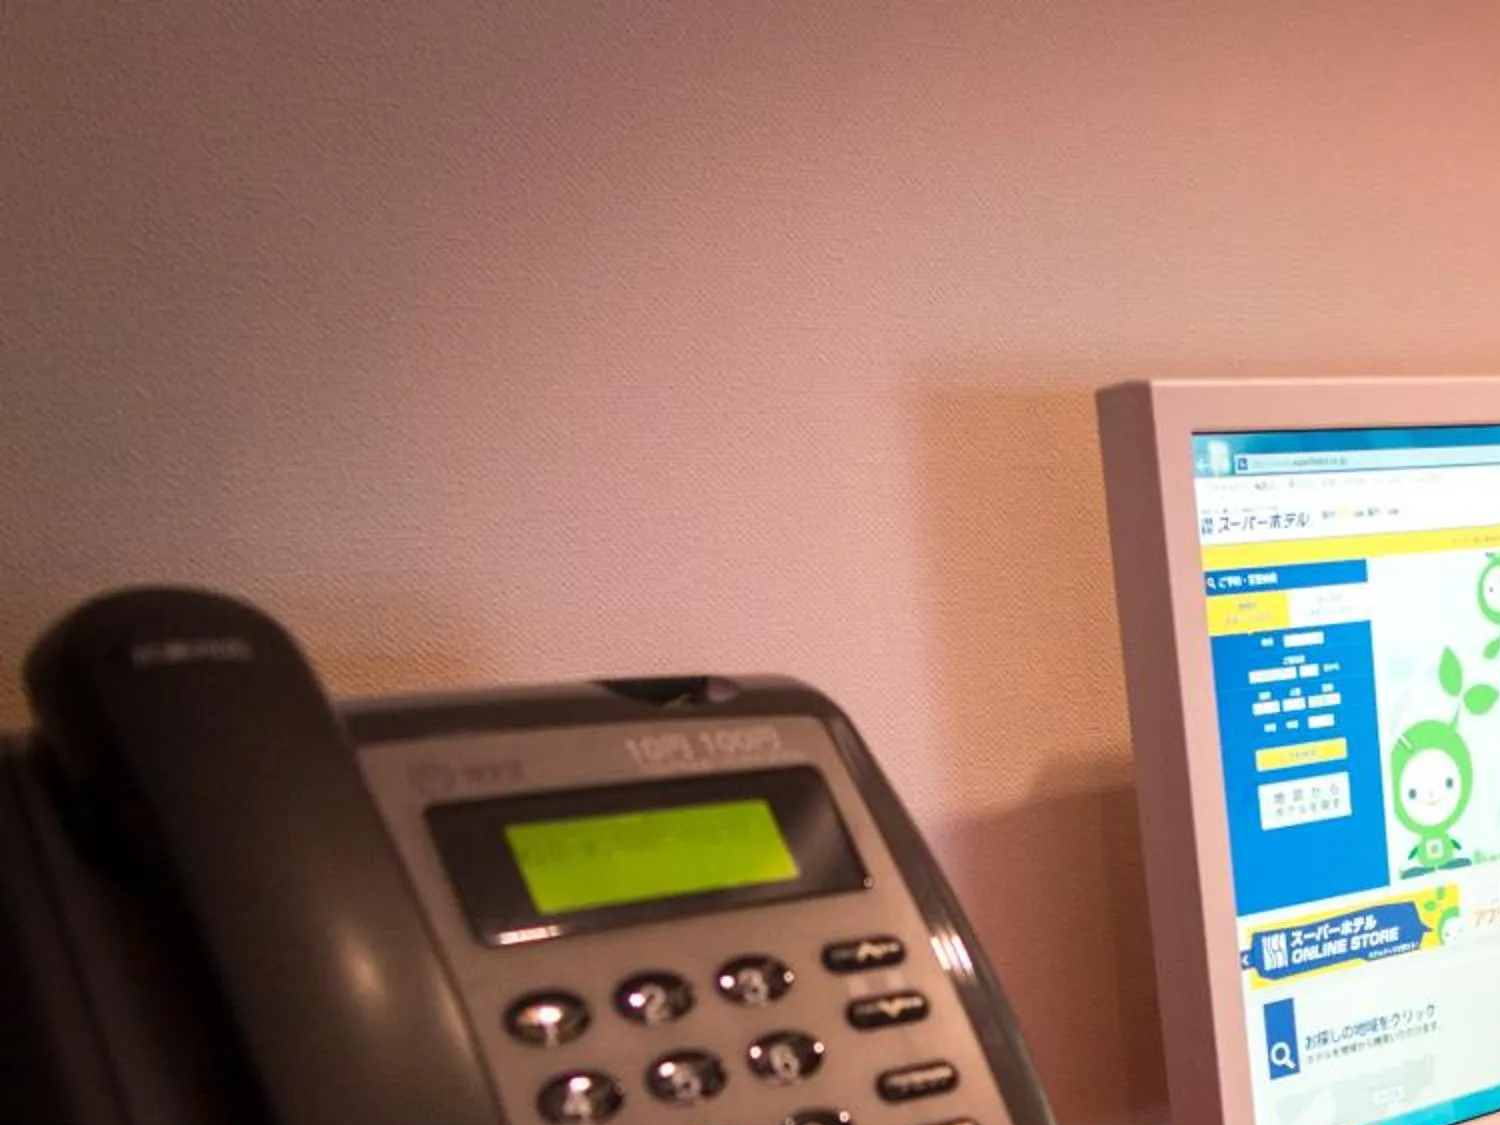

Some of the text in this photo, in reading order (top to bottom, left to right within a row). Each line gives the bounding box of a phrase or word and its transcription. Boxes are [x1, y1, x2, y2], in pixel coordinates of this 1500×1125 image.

[1218, 511, 1311, 534] スーパーホテル
[1290, 914, 1377, 947] スーパーホテル
[1291, 938, 1348, 965] ONLINE
[1350, 926, 1400, 951] STORE
[1305, 1003, 1436, 1051] お探しの地域をクリック
